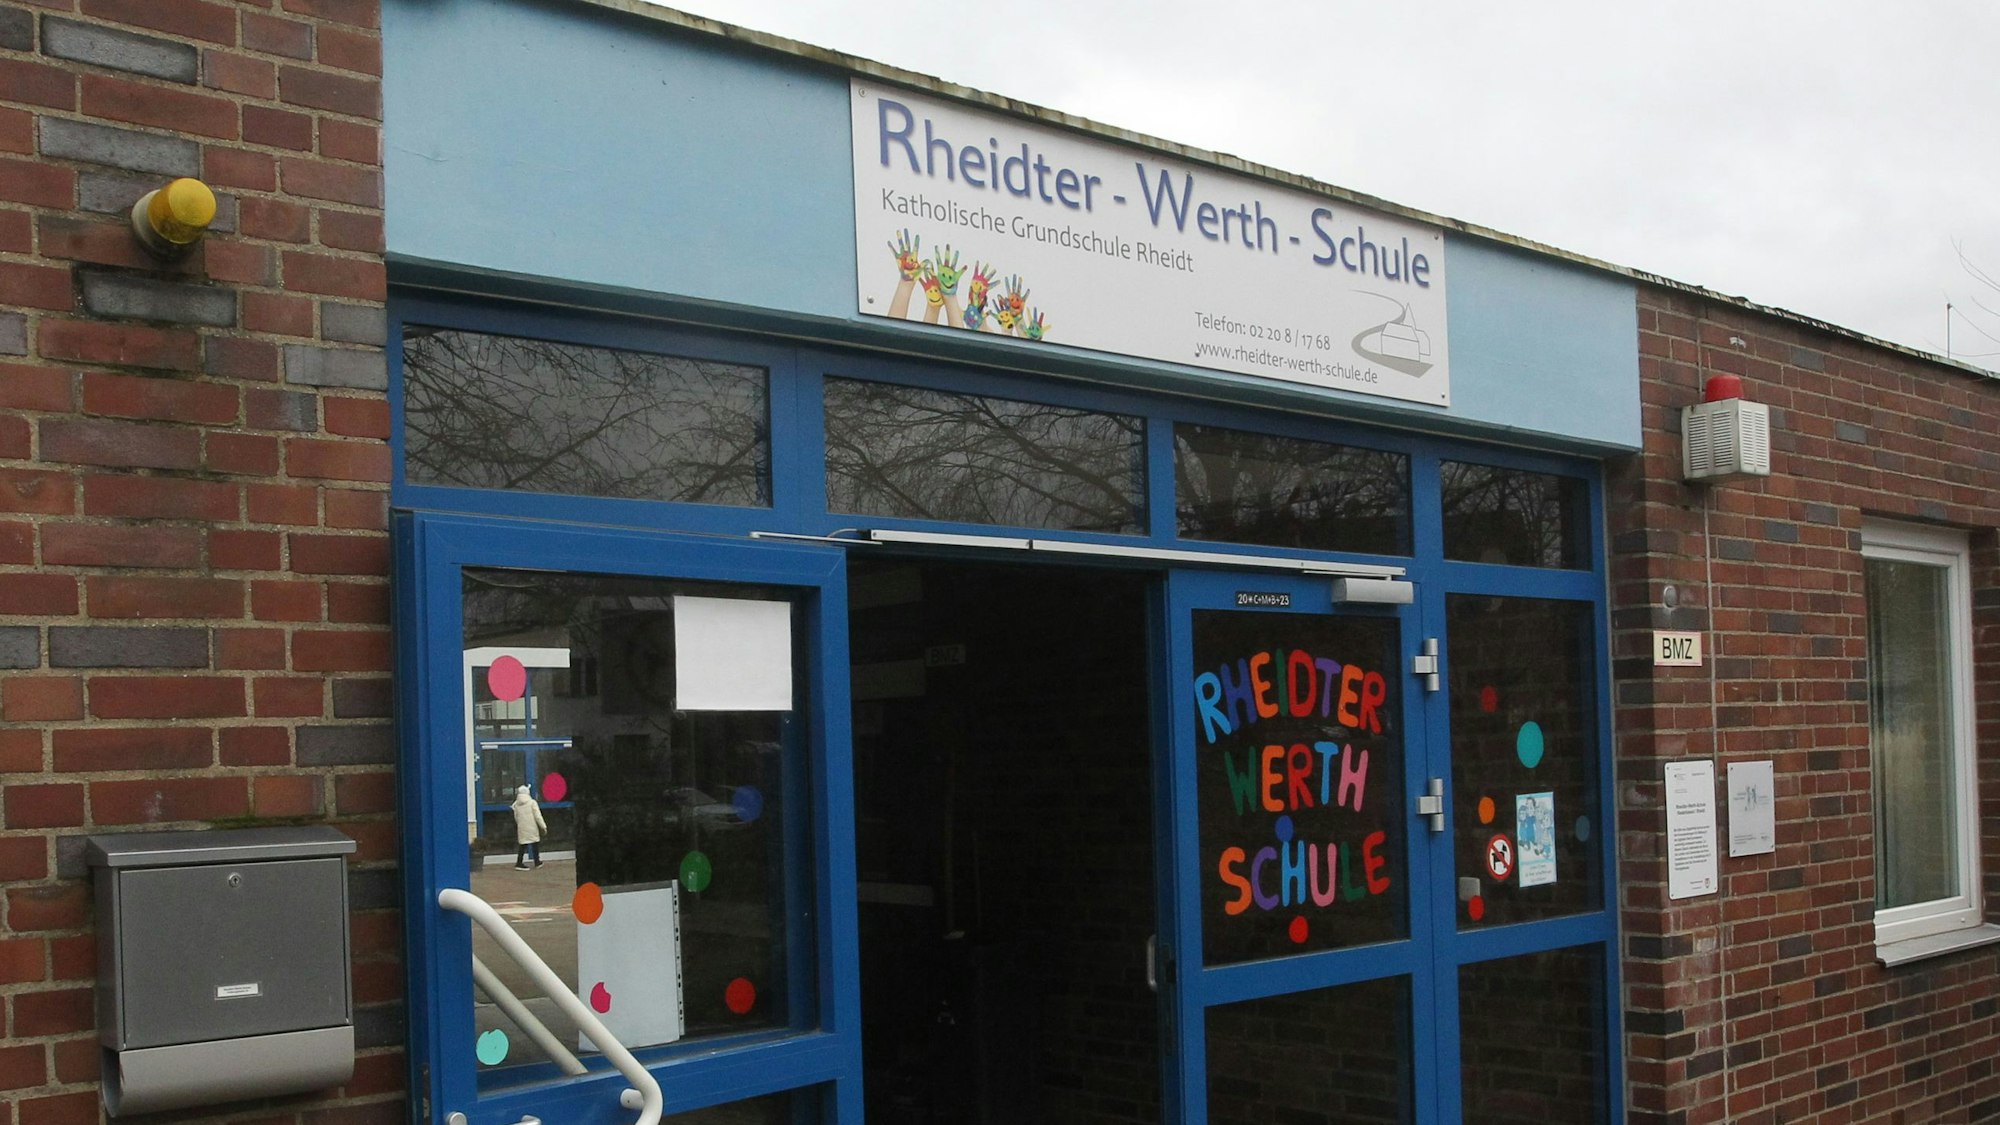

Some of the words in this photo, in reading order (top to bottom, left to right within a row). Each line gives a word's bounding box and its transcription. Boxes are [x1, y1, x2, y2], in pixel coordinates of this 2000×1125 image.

[878, 98, 1101, 212] Rheidter
[1136, 162, 1278, 254] Werth
[1311, 207, 1430, 288] Schule
[882, 188, 1006, 234] Katholische
[1011, 216, 1131, 259] Grundschule
[1136, 242, 1194, 273] Rheidt
[1195, 312, 1246, 335] Telefon:
[1250, 324, 1263, 339] 02
[1267, 327, 1281, 342] 20
[1284, 328, 1292, 344] 8
[1302, 334, 1313, 350] 17
[1316, 334, 1331, 351] 68
[1196, 343, 1378, 384] www.rheidter-werth-schule.de
[1662, 637, 1693, 660] BMZ
[1194, 649, 1387, 744] RHEIDTER
[1225, 741, 1369, 816] WERTH
[1219, 831, 1391, 916] SCHULE
